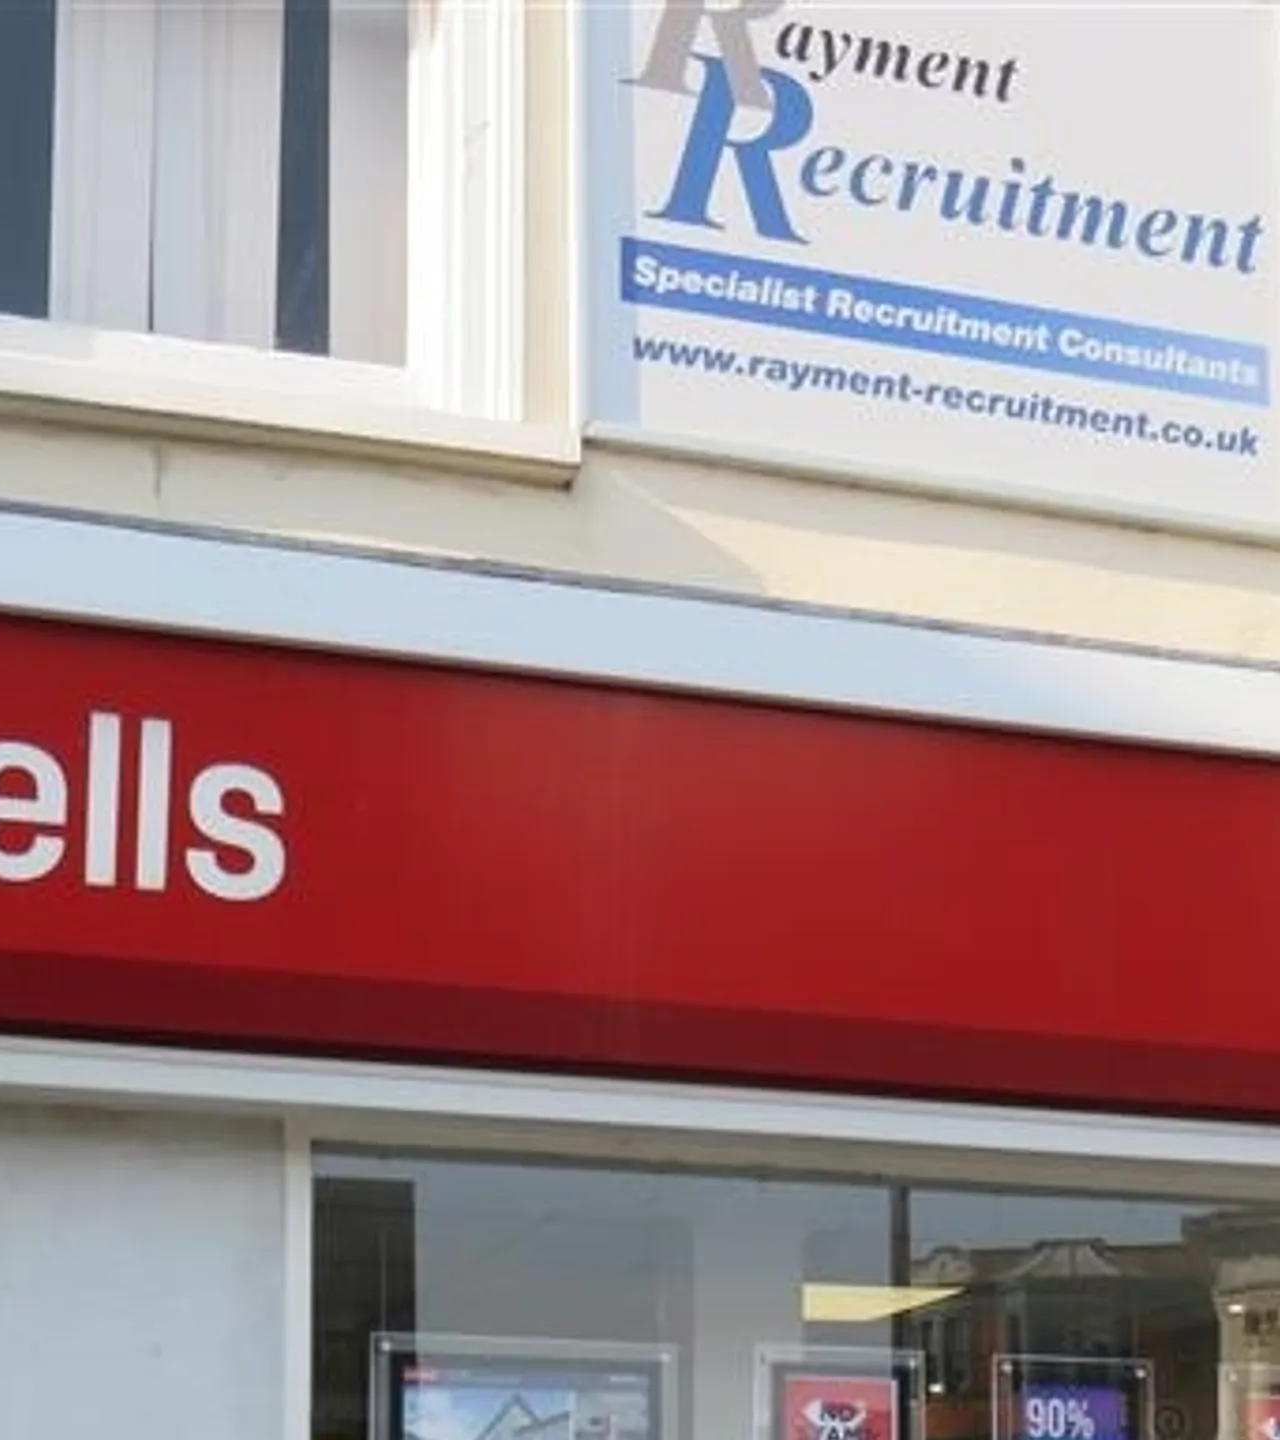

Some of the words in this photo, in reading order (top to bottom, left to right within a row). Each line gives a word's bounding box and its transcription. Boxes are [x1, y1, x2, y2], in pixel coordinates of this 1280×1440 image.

[644, 53, 1266, 274] Recruitment
[634, 256, 817, 314] Specialist
[827, 289, 1048, 354] Recruitment
[1058, 329, 1259, 387] Consultants
[633, 334, 1258, 456] www.rayment-recruitment.co.uk
[1026, 1397, 1096, 1440] 90%
